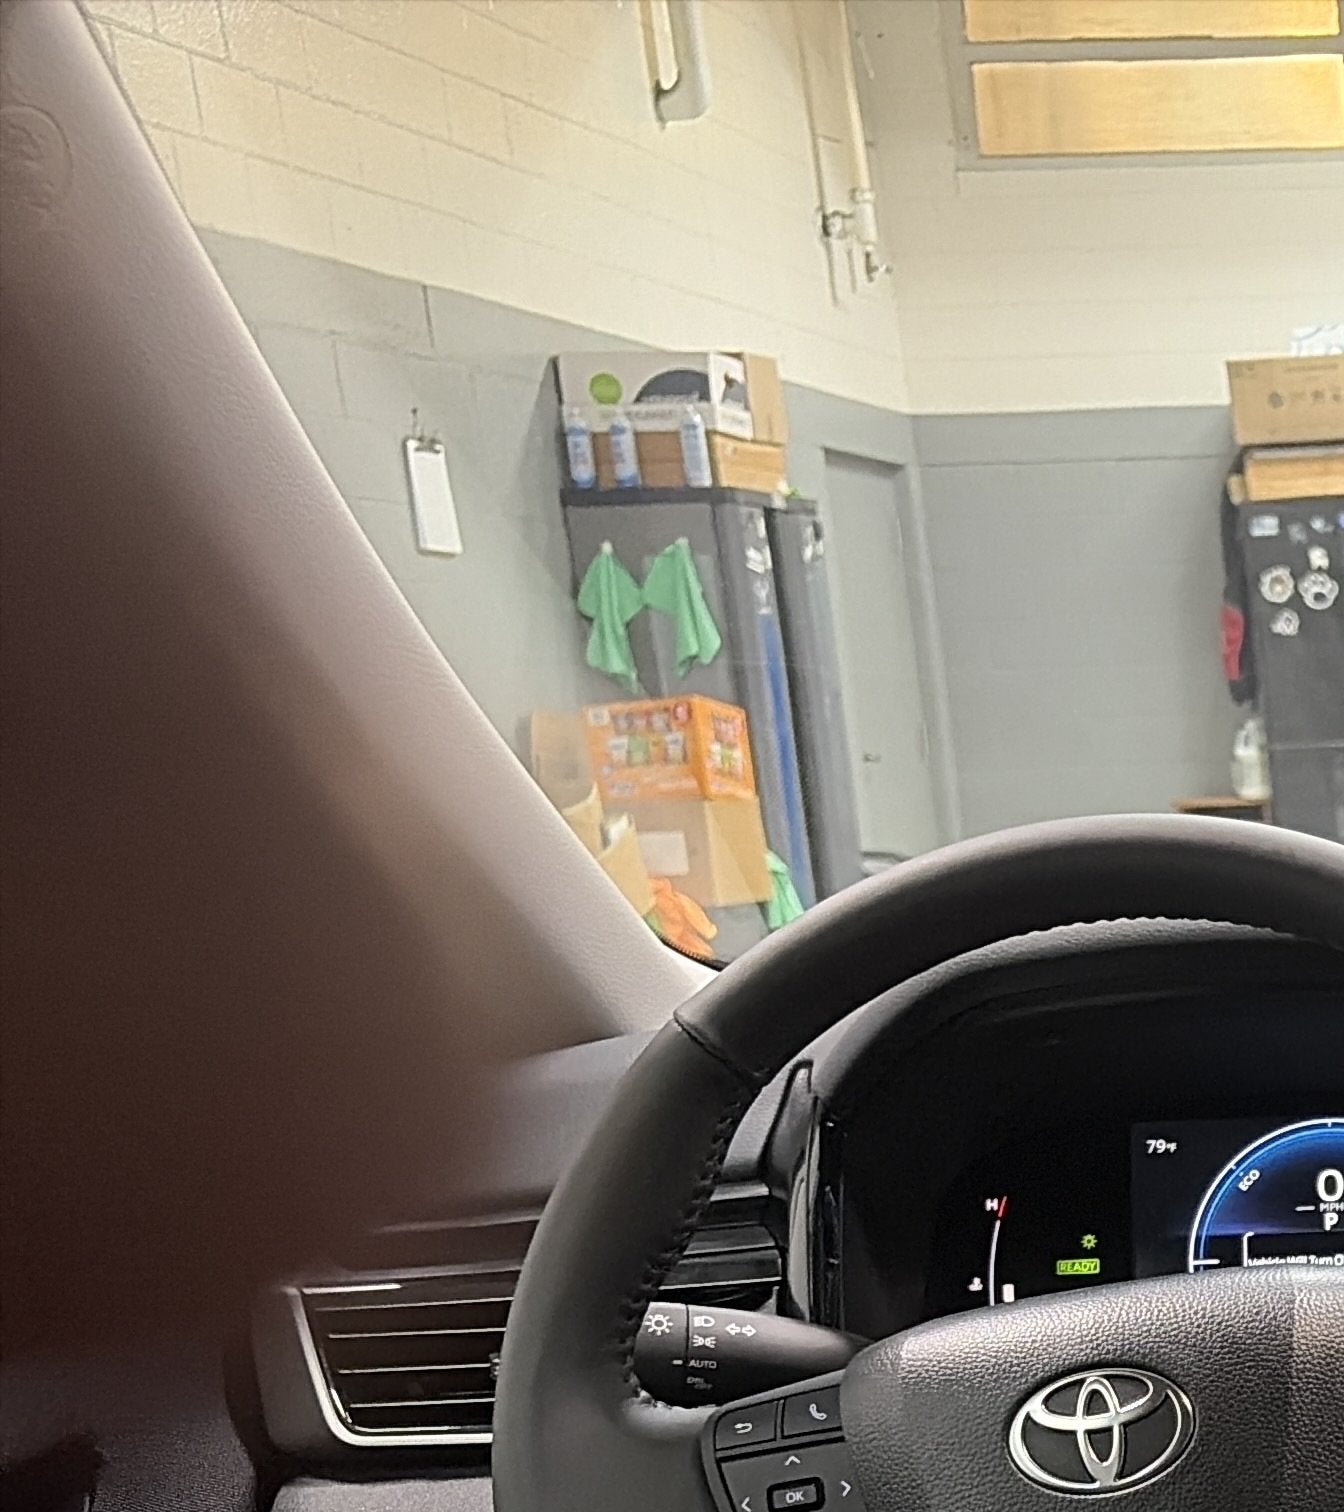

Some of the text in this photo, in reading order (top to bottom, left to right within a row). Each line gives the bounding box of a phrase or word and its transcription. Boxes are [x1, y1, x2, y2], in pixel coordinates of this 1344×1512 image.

[1238, 1169, 1260, 1192] ECO
[1316, 1168, 1344, 1202] 0
[985, 1198, 998, 1211] H
[1319, 1203, 1344, 1212] MPH
[1323, 1212, 1339, 1231] P
[1059, 1261, 1096, 1272] READY
[688, 1359, 717, 1369] AUTO
[785, 1490, 804, 1503] OK
